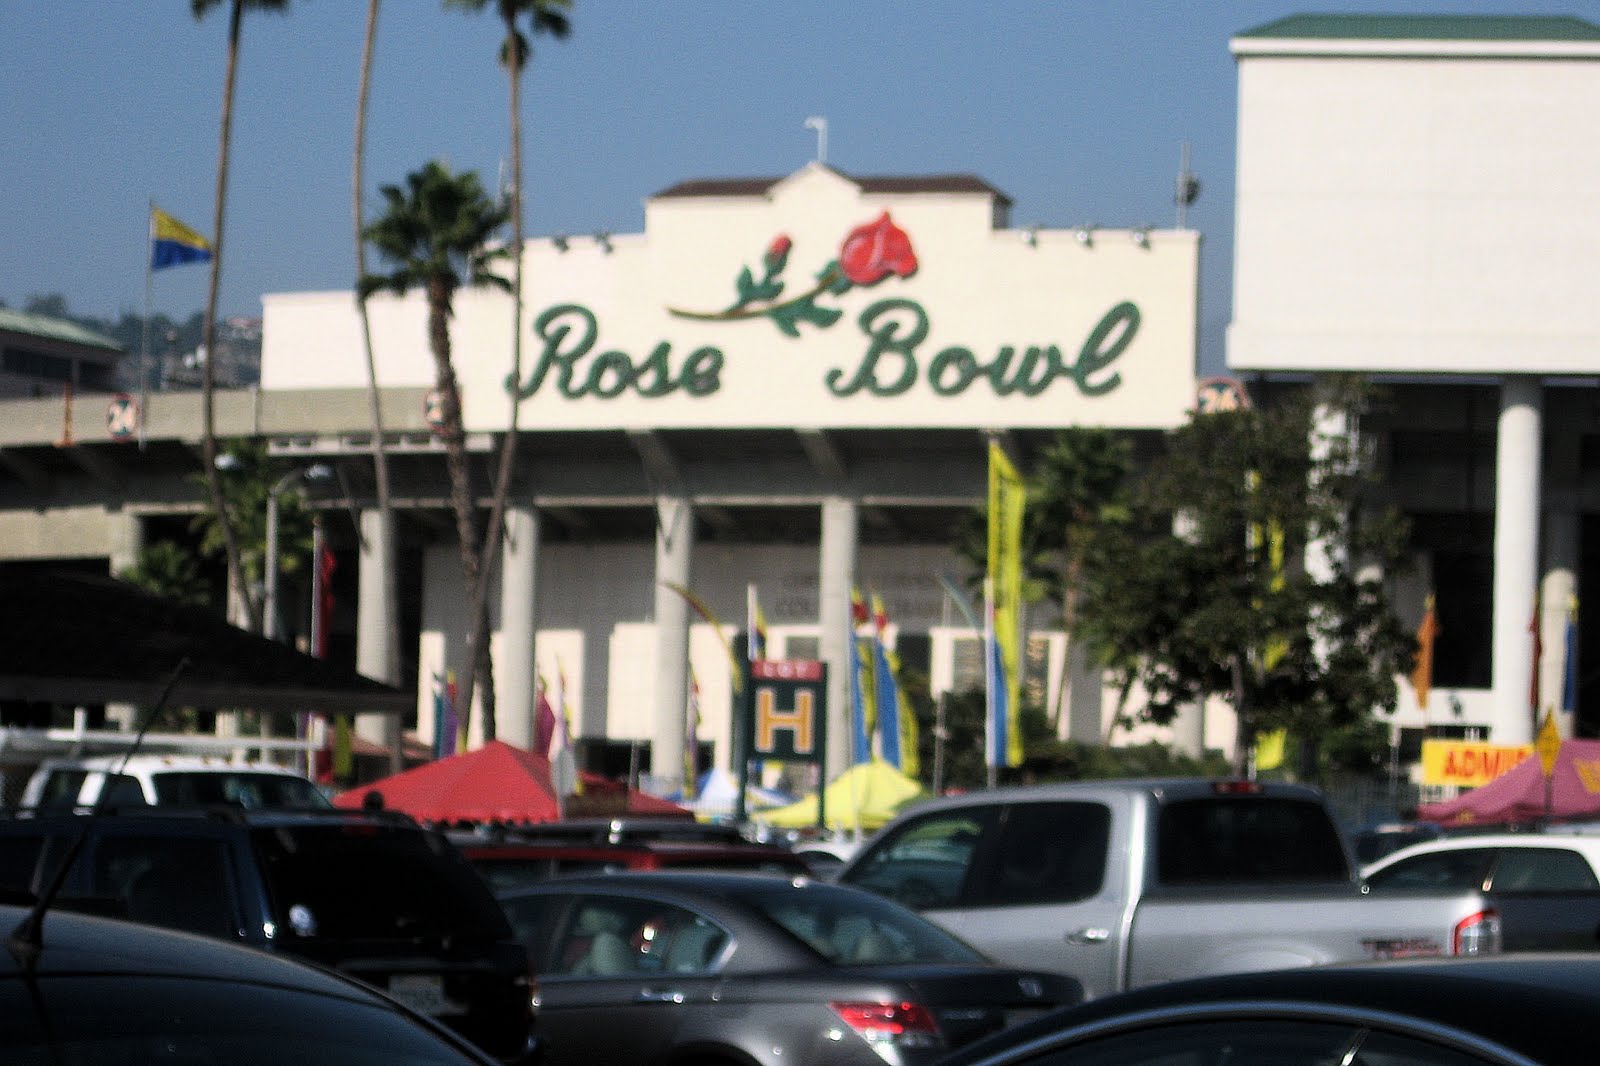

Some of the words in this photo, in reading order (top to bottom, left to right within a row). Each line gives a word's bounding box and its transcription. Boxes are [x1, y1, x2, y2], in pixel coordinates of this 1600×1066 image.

[506, 303, 725, 401] Rose
[826, 300, 1142, 399] Bowl
[754, 688, 814, 754] H
